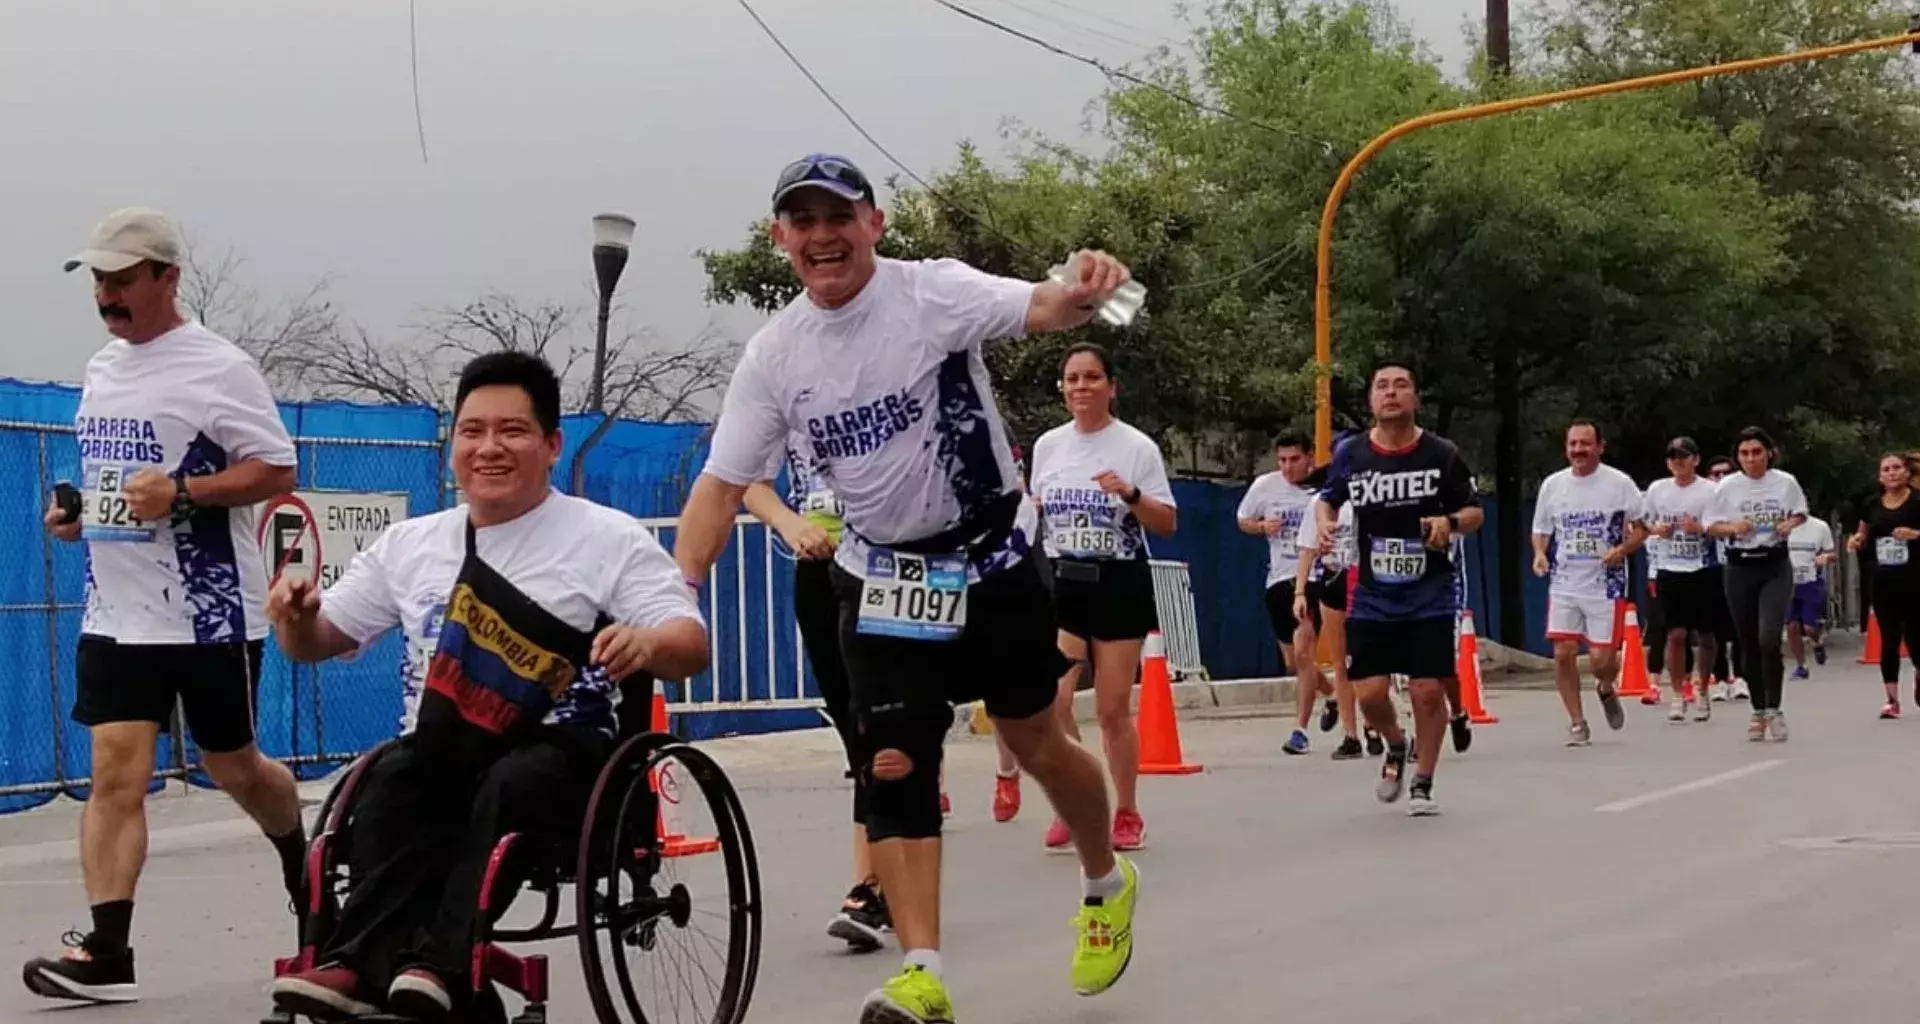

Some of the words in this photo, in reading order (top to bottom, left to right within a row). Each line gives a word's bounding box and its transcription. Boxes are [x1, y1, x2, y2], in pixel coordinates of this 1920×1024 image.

[80, 439, 164, 464] ORREGOS
[1348, 468, 1441, 507] EXATEC
[327, 505, 391, 531] ENTRADA
[1072, 531, 1114, 549] 1636
[1384, 557, 1423, 573] 1667
[891, 585, 962, 623] 1097
[458, 594, 541, 673] COLOMBIA
